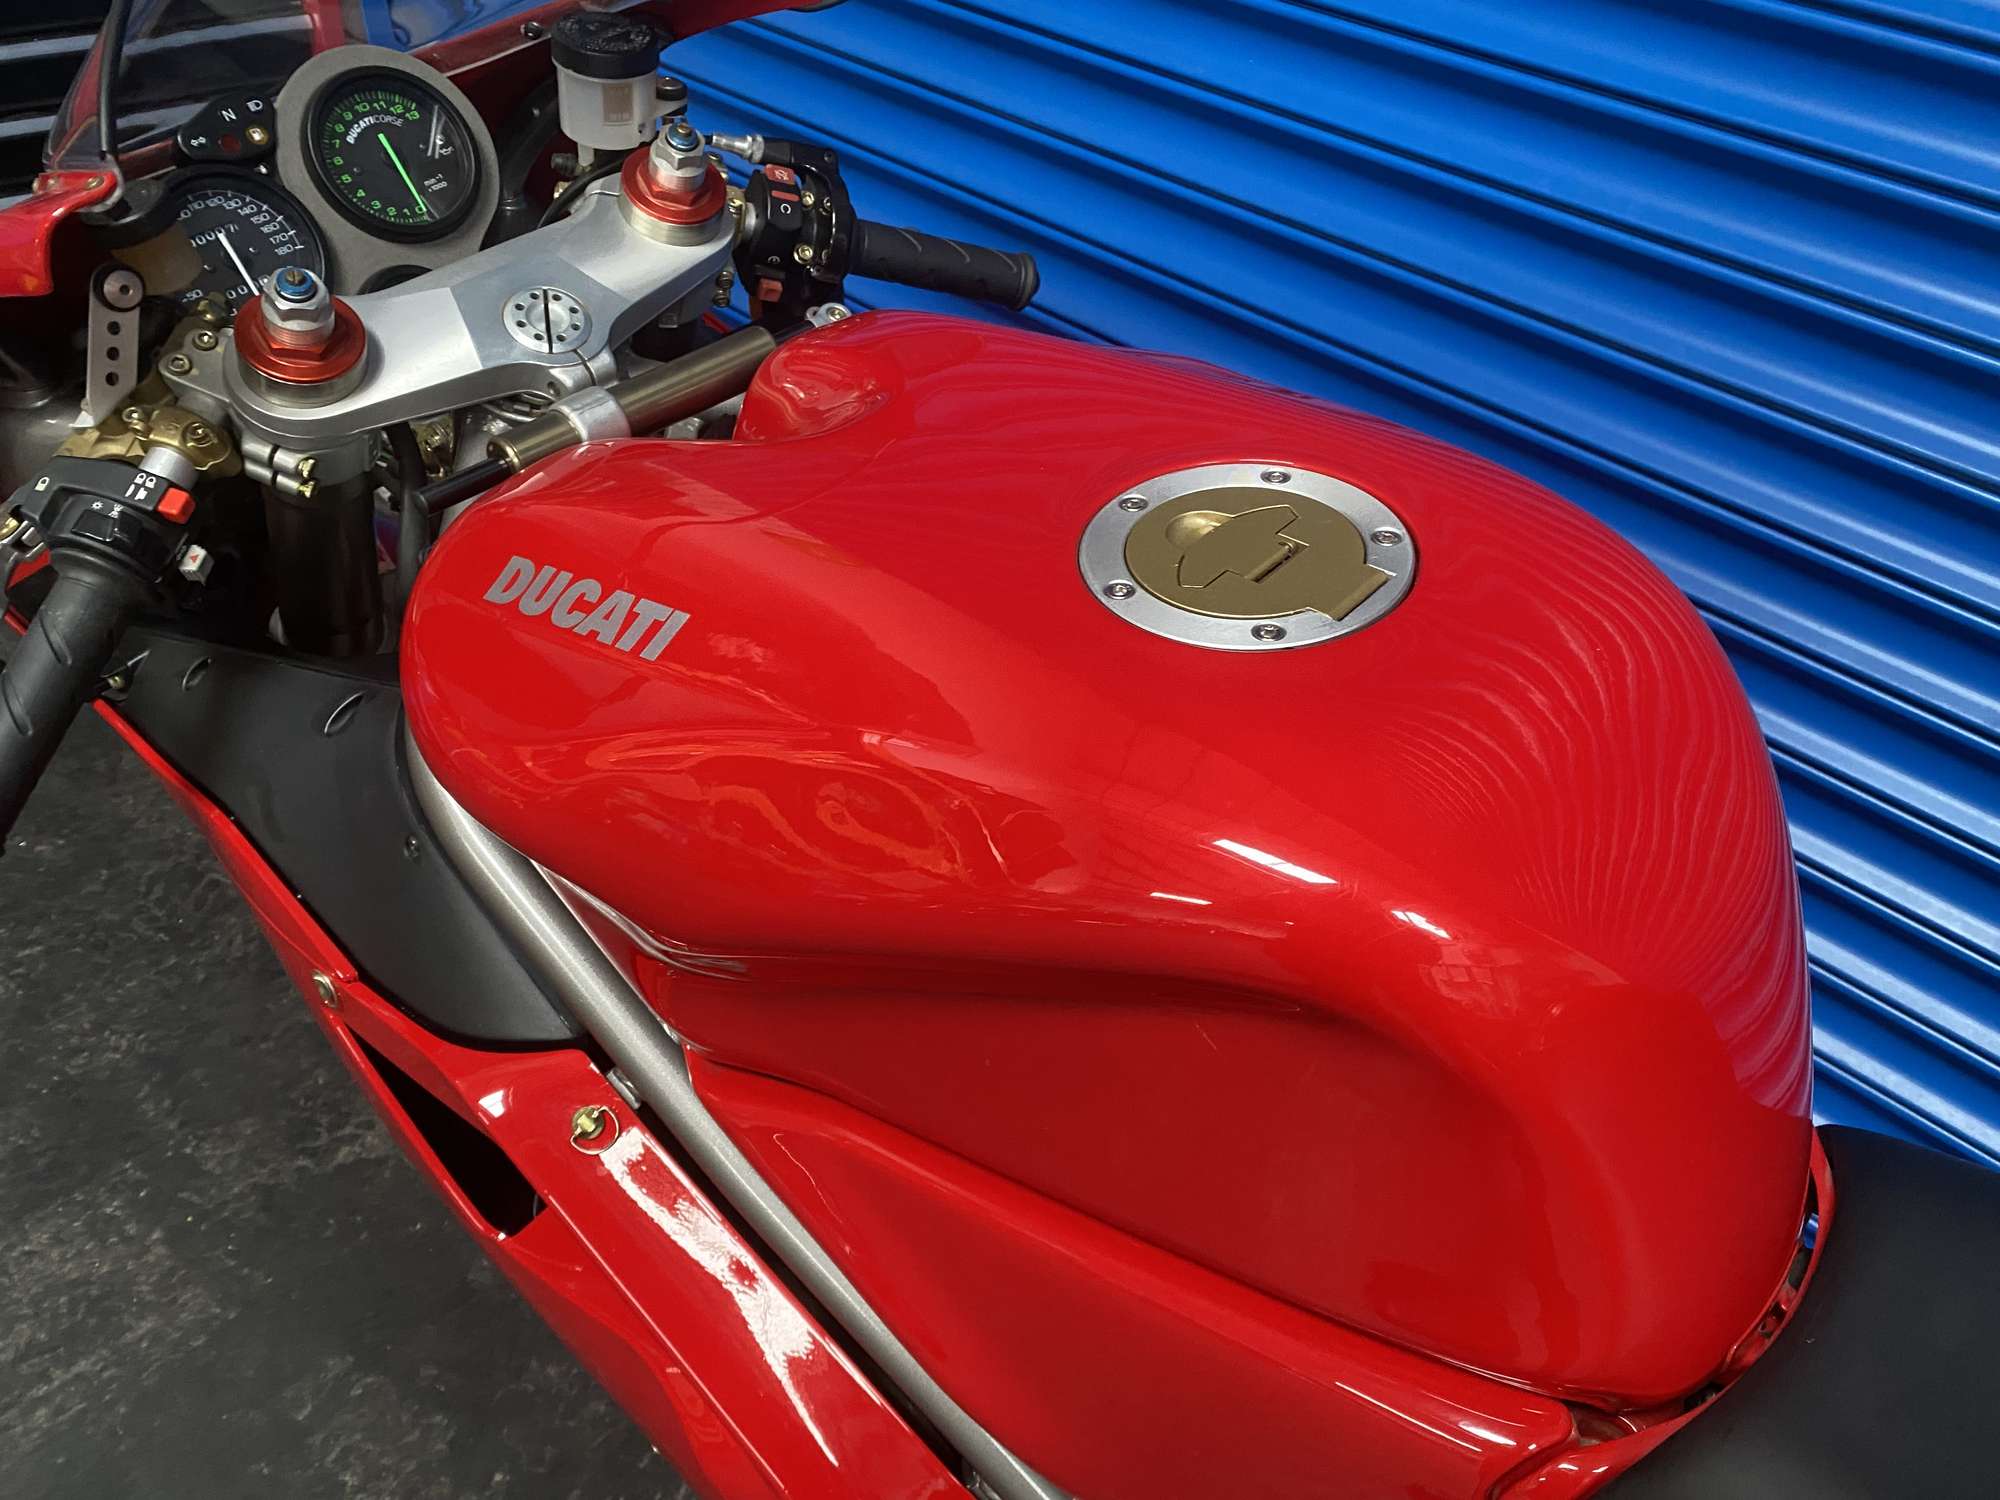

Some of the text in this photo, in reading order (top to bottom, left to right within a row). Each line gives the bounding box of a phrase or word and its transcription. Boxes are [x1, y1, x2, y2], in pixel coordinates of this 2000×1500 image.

[354, 102, 370, 113] 10
[389, 104, 405, 115] 12
[221, 108, 237, 122] N
[342, 111, 353, 121] 9
[405, 110, 420, 120] 13
[332, 139, 341, 149] 7
[356, 189, 366, 198] 4
[237, 204, 257, 216] 140
[371, 200, 382, 209] 3
[386, 207, 398, 216] 2
[250, 212, 270, 225] 150
[269, 232, 289, 245] 170
[483, 555, 692, 661] DUCATI
